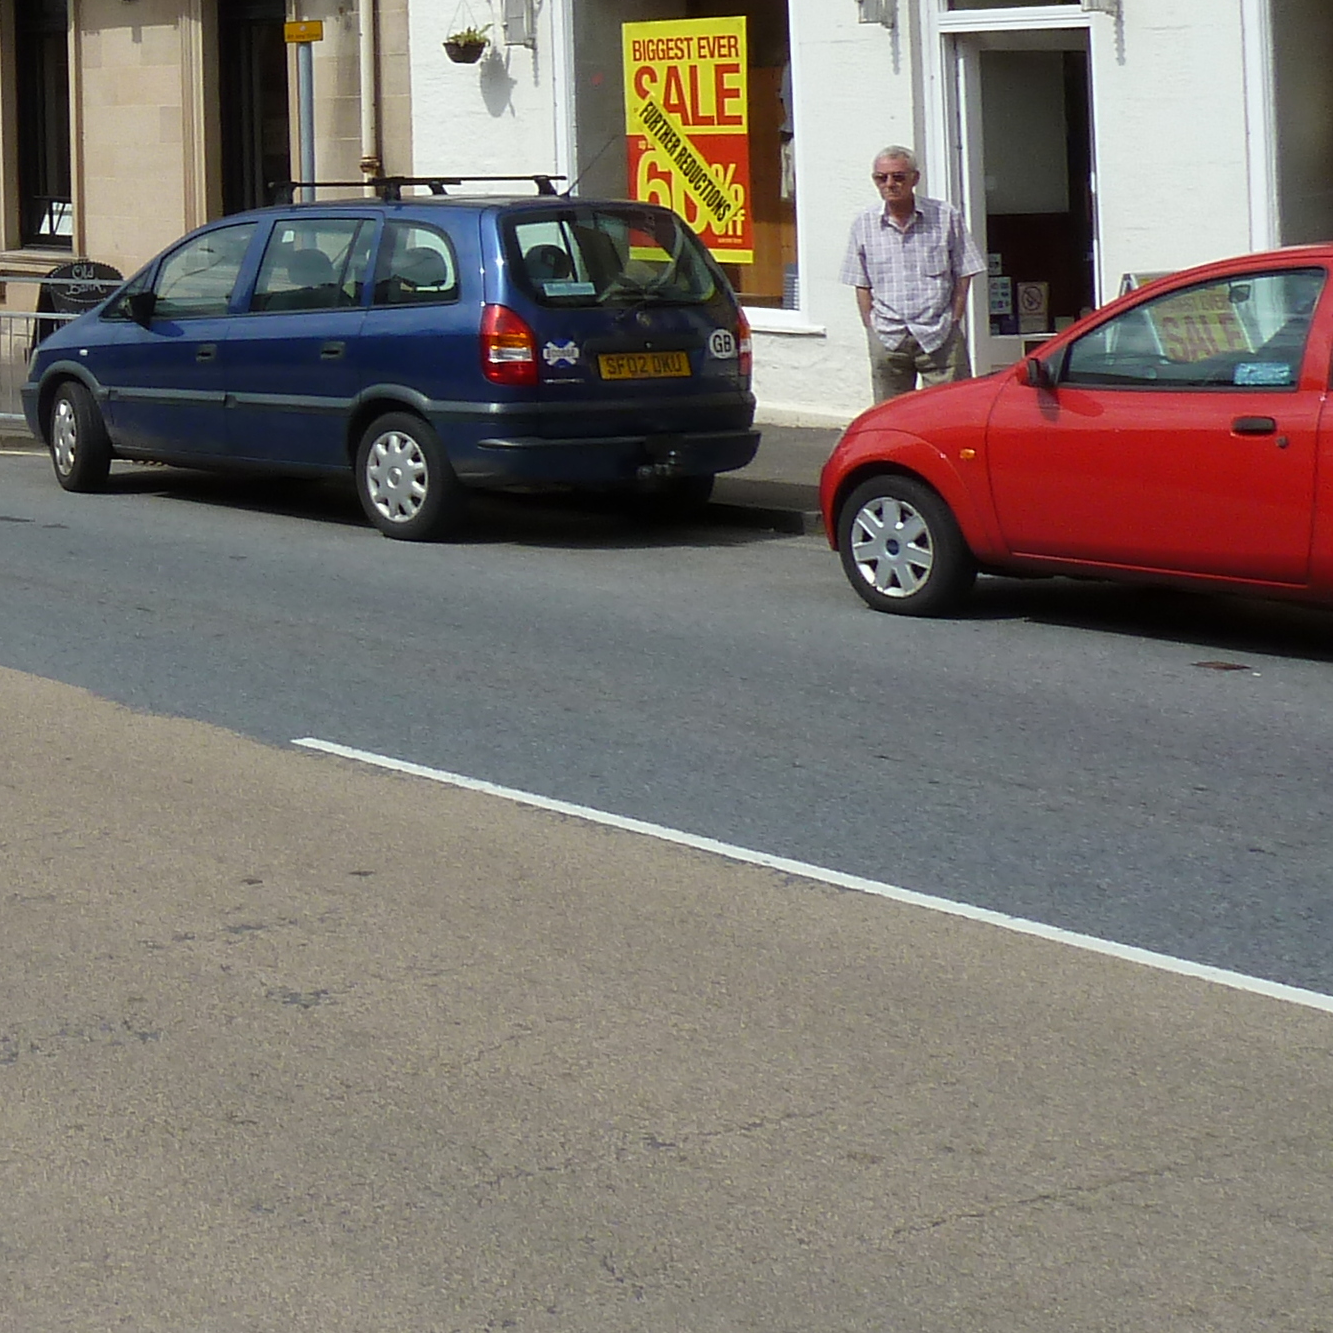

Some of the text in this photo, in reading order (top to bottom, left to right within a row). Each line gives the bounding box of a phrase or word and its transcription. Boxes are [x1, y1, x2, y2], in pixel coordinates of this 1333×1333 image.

[632, 35, 739, 62] BIGGEST EVER
[639, 101, 679, 157] FURTHER
[674, 145, 732, 223] REDUCTIONS
[72, 264, 94, 280] Old
[712, 334, 732, 354] GB
[1162, 313, 1242, 363] SALE
[606, 355, 649, 375] SF02
